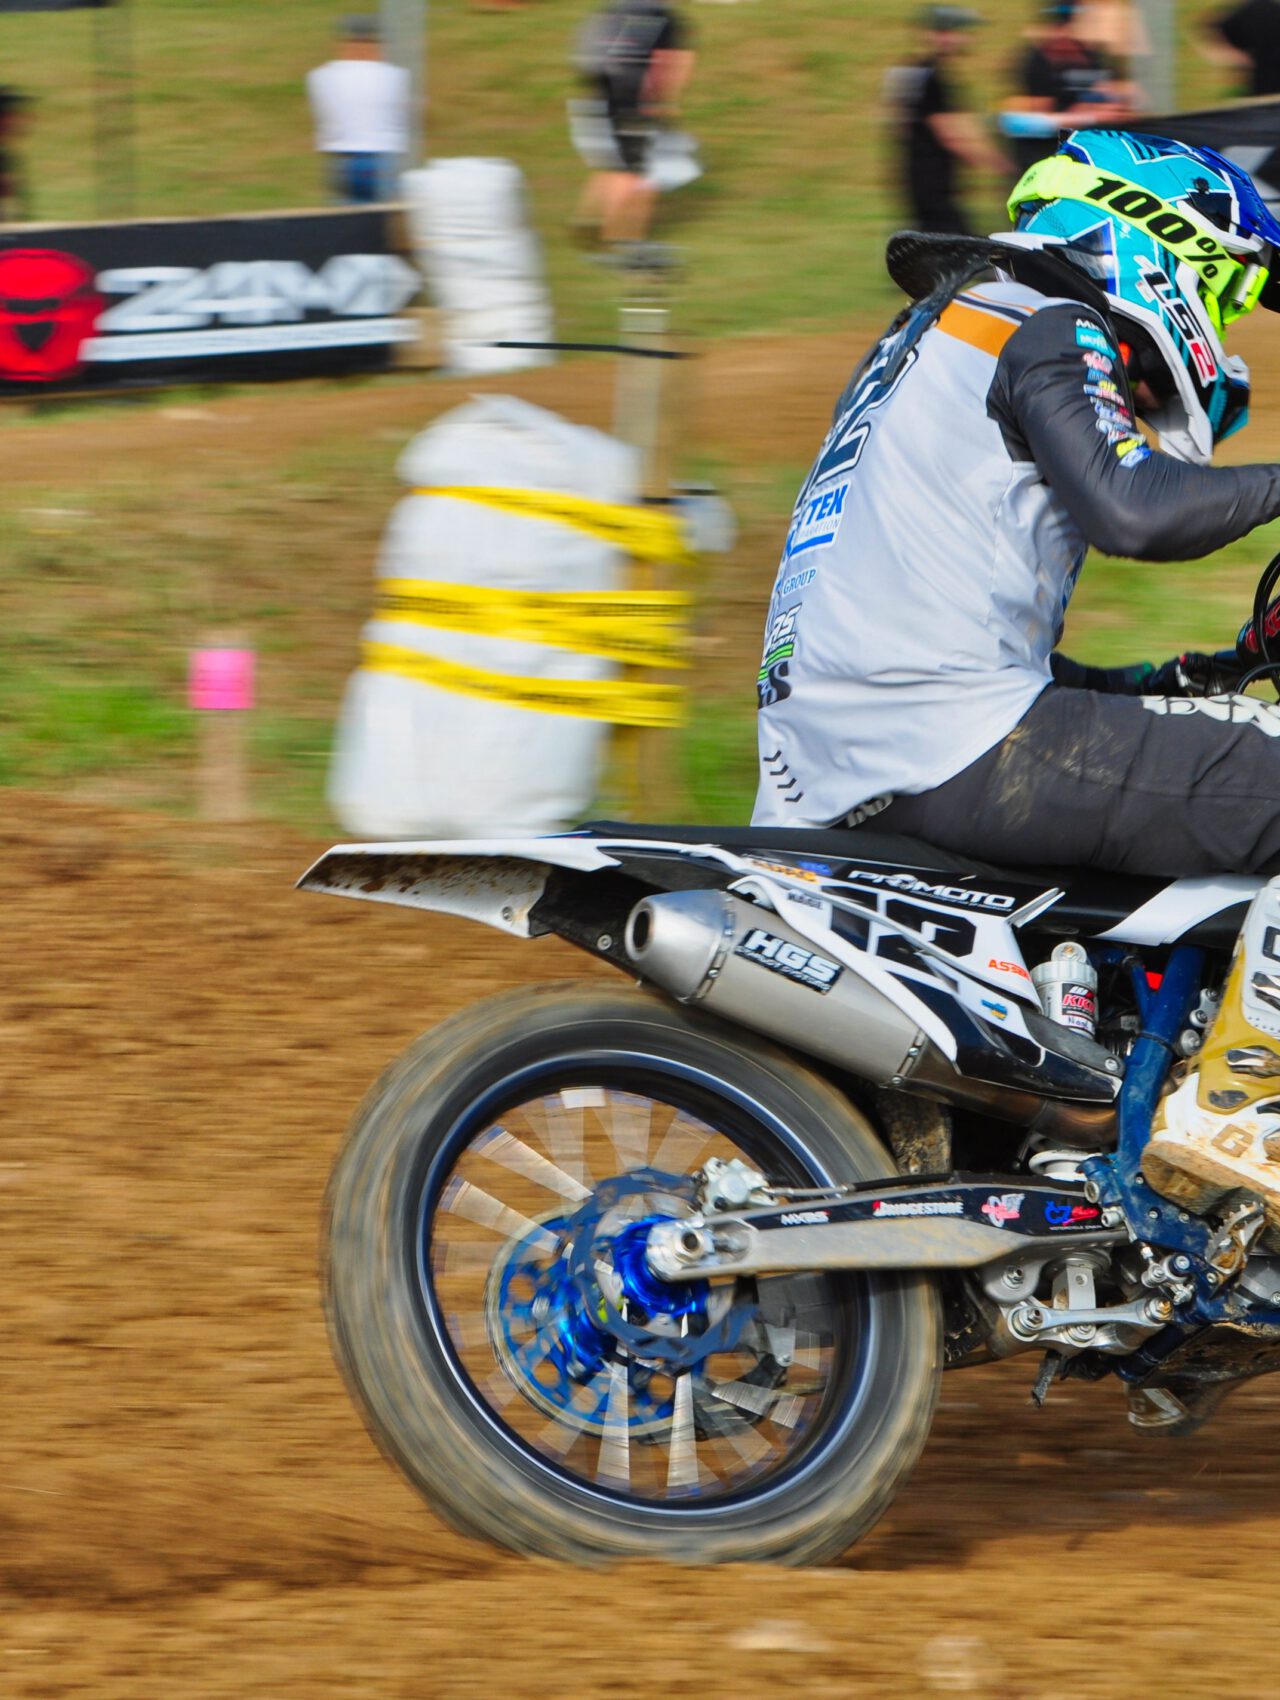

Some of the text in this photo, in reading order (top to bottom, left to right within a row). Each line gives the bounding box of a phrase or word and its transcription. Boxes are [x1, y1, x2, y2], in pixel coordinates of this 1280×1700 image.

[1085, 177, 1228, 279] 100%
[1143, 271, 1217, 380] LS2
[783, 569, 817, 595] GROUP
[744, 929, 841, 982] HGS
